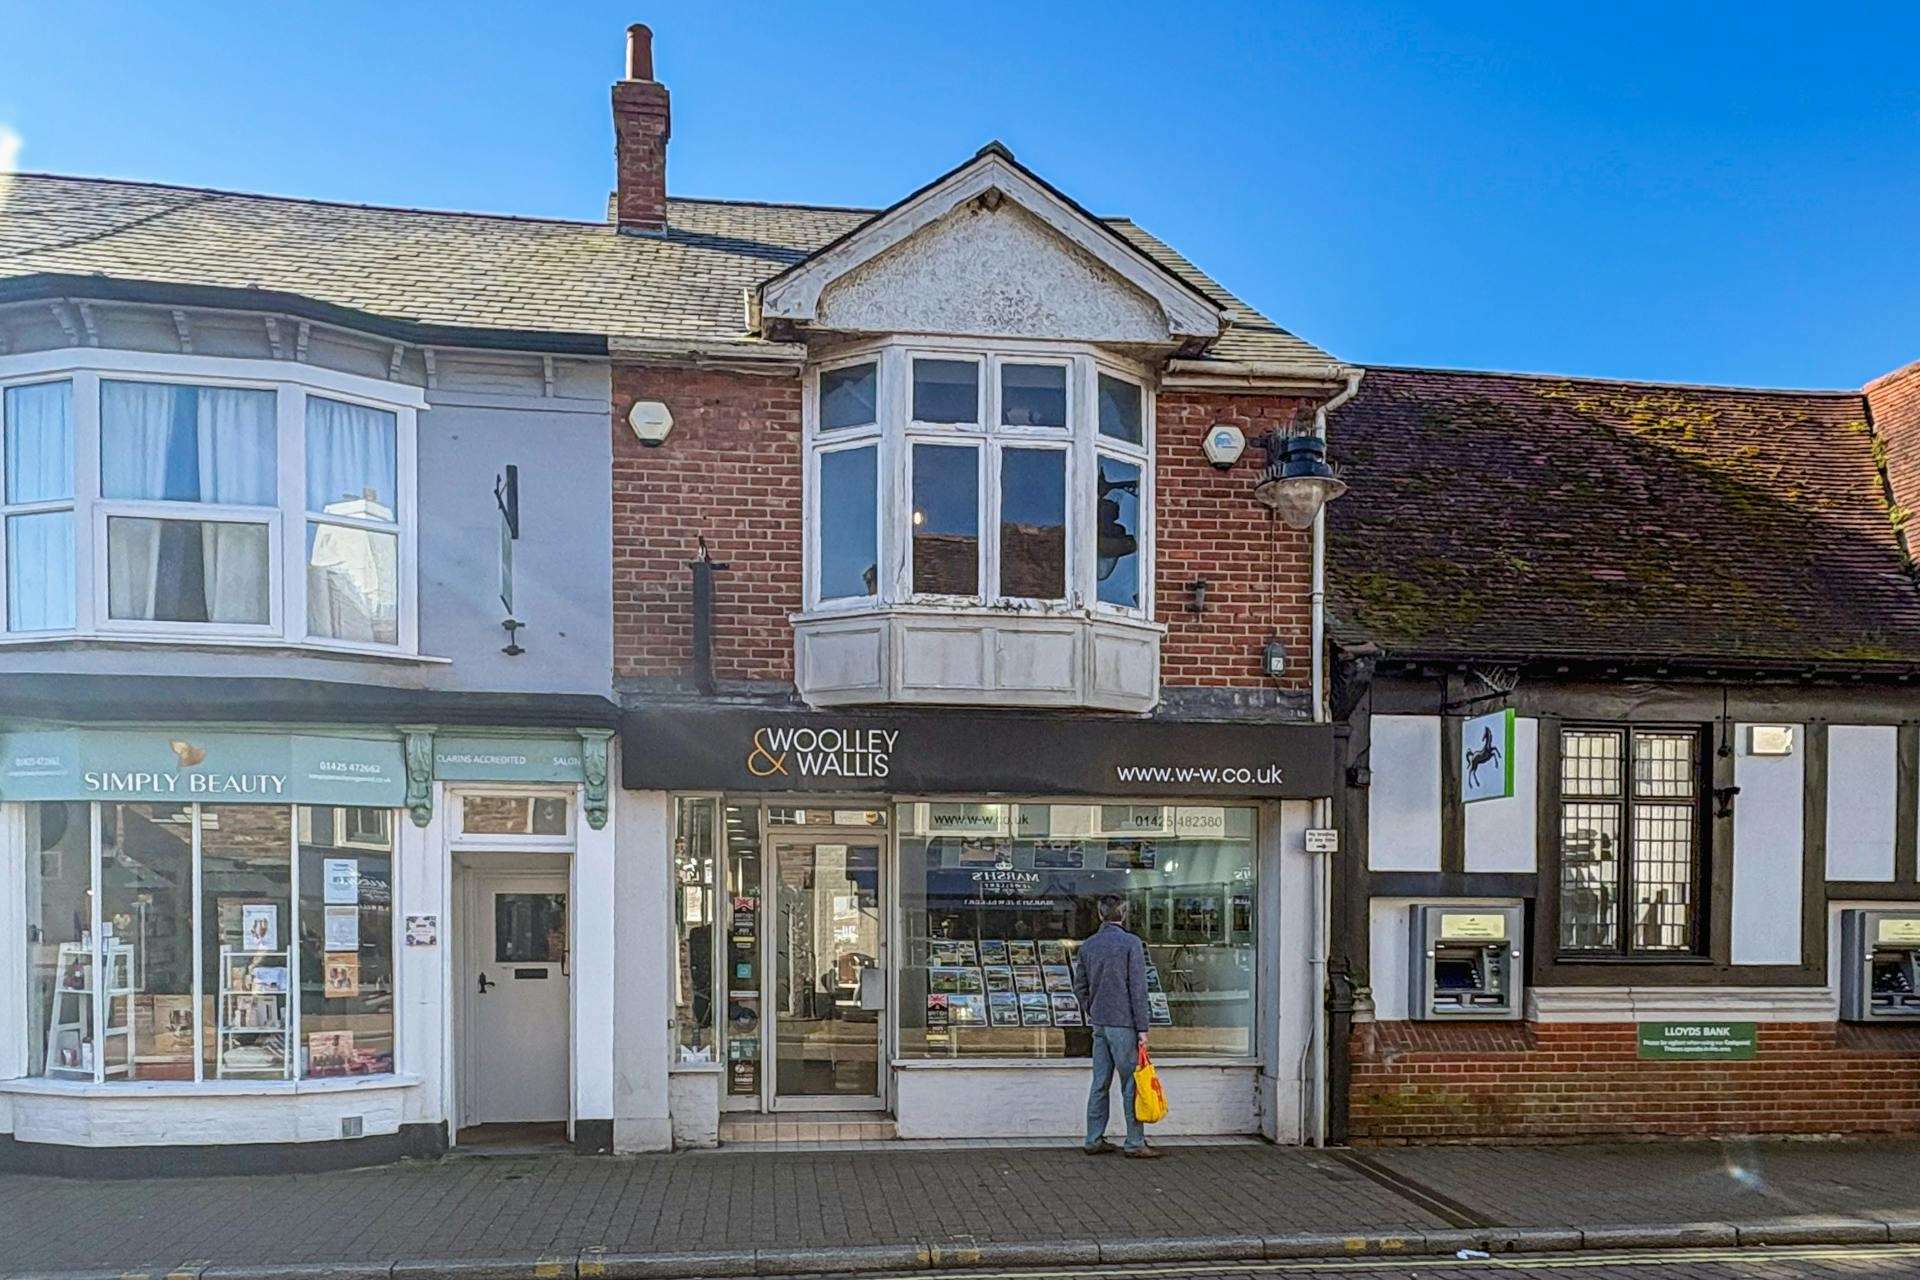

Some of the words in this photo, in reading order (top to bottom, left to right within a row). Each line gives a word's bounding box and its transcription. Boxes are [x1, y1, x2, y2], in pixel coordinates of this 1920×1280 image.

[766, 727, 899, 753] WOOLLEY
[748, 728, 788, 776] &
[797, 752, 889, 777] WALLIS
[319, 761, 347, 772] 01425
[436, 754, 471, 764] CLARINS
[473, 755, 527, 765] ACCREDITED
[553, 757, 581, 766] SALON
[1117, 764, 1283, 784] www.w-w.co.uk
[84, 771, 180, 793] SIMPLY
[190, 773, 287, 794] BEAUTY
[934, 814, 1029, 825] www.w-w.co.uk
[1135, 815, 1174, 827] 01425
[1177, 816, 1222, 828] 482380
[1664, 1026, 1701, 1036] LLOYDS
[1703, 1027, 1731, 1037] BANK
